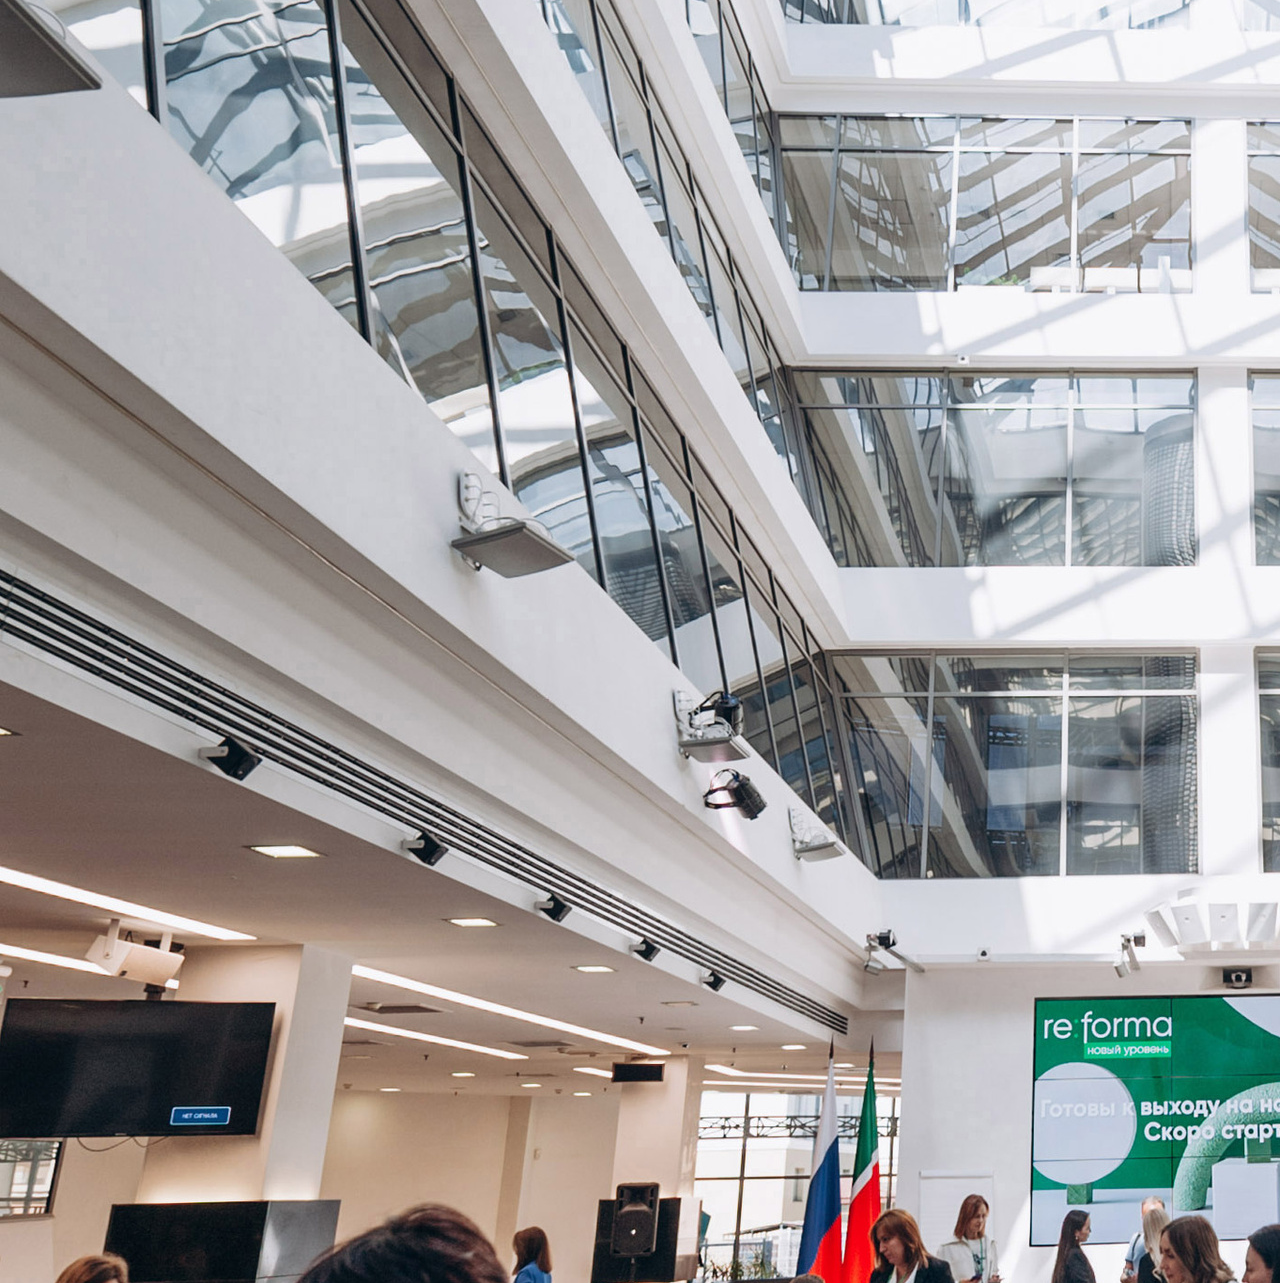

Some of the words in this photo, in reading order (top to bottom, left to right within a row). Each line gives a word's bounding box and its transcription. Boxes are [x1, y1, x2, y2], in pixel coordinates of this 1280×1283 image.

[1044, 1010, 1172, 1044] re:forma
[1087, 1044, 1121, 1056] новый
[1124, 1045, 1170, 1057] уровень
[1040, 1099, 1115, 1118] Готовы
[1122, 1102, 1135, 1117] к
[1140, 1099, 1220, 1118] выходу
[1226, 1098, 1254, 1114] на
[1144, 1121, 1215, 1145] Скоро
